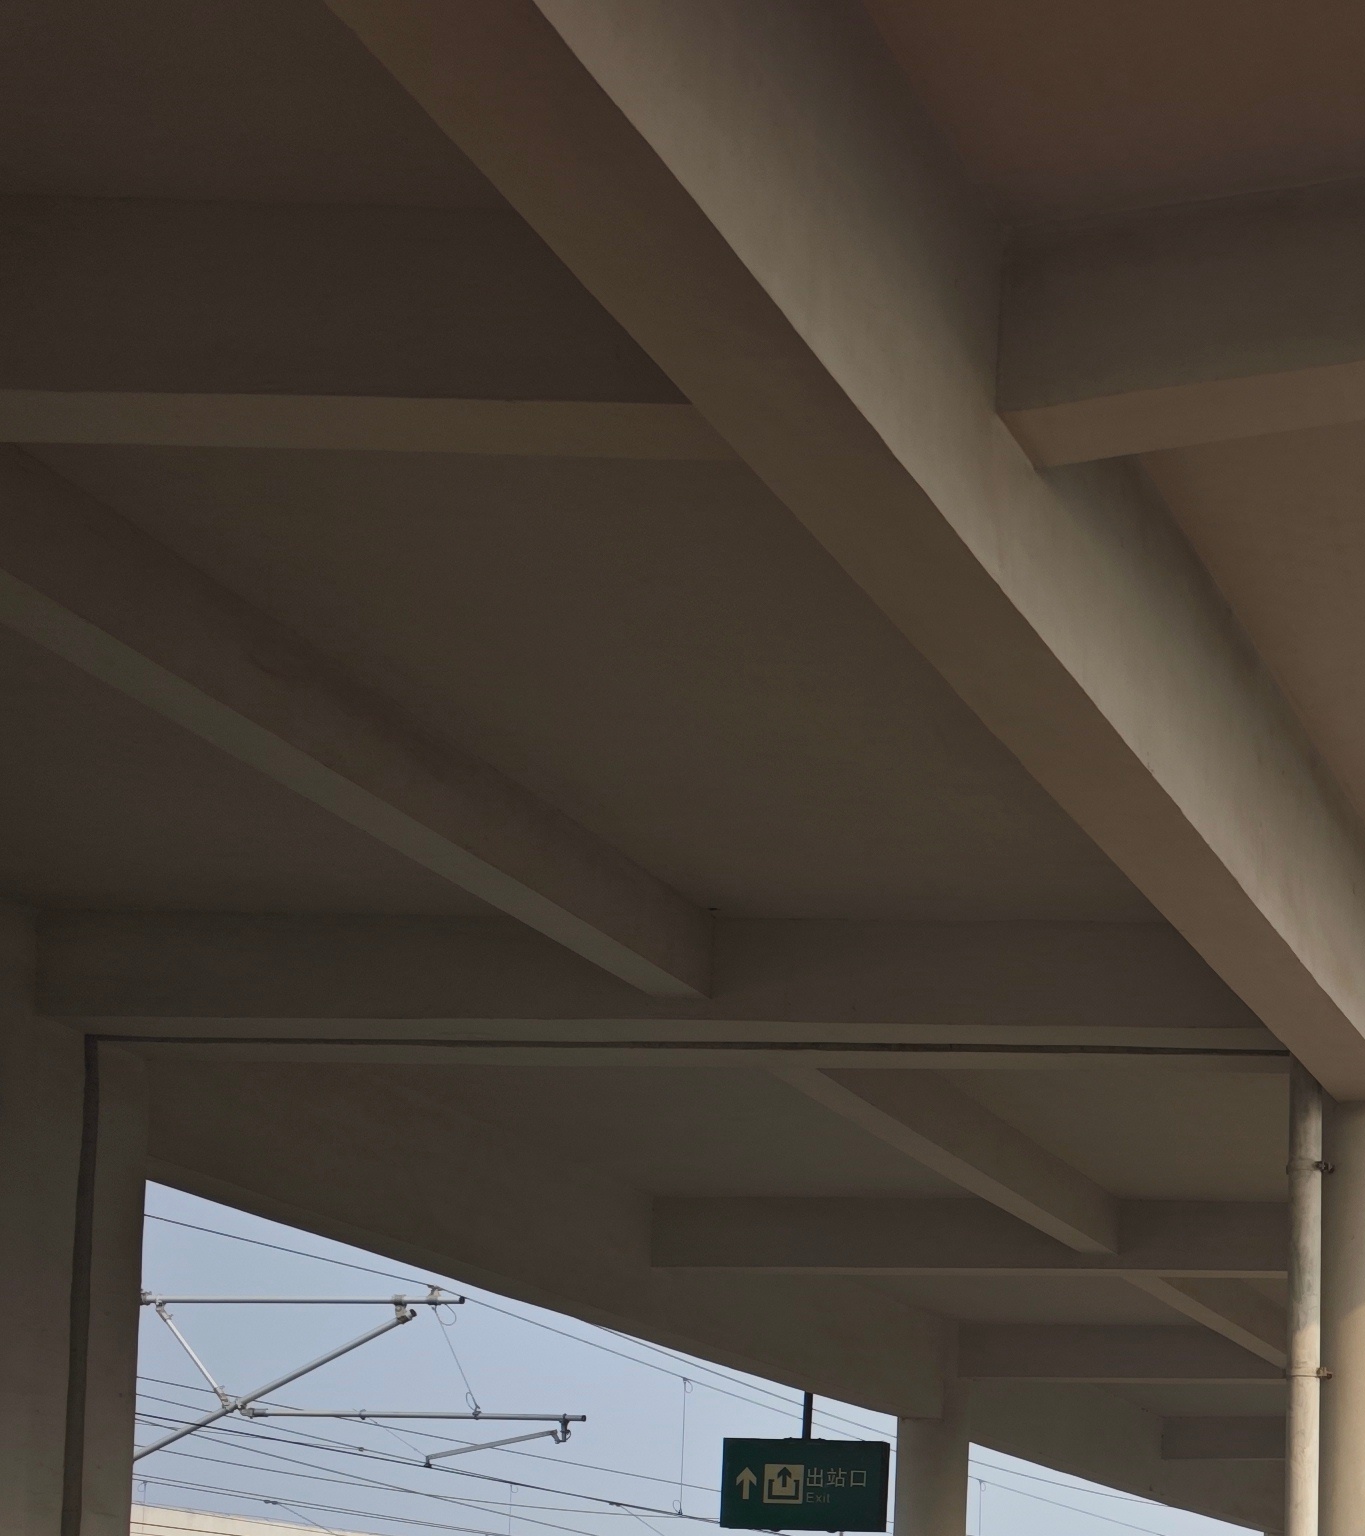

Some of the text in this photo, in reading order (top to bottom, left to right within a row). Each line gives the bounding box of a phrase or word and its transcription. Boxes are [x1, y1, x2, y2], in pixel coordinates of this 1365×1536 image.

[806, 1467, 867, 1488] 出站口
[806, 1492, 830, 1503] Exit
